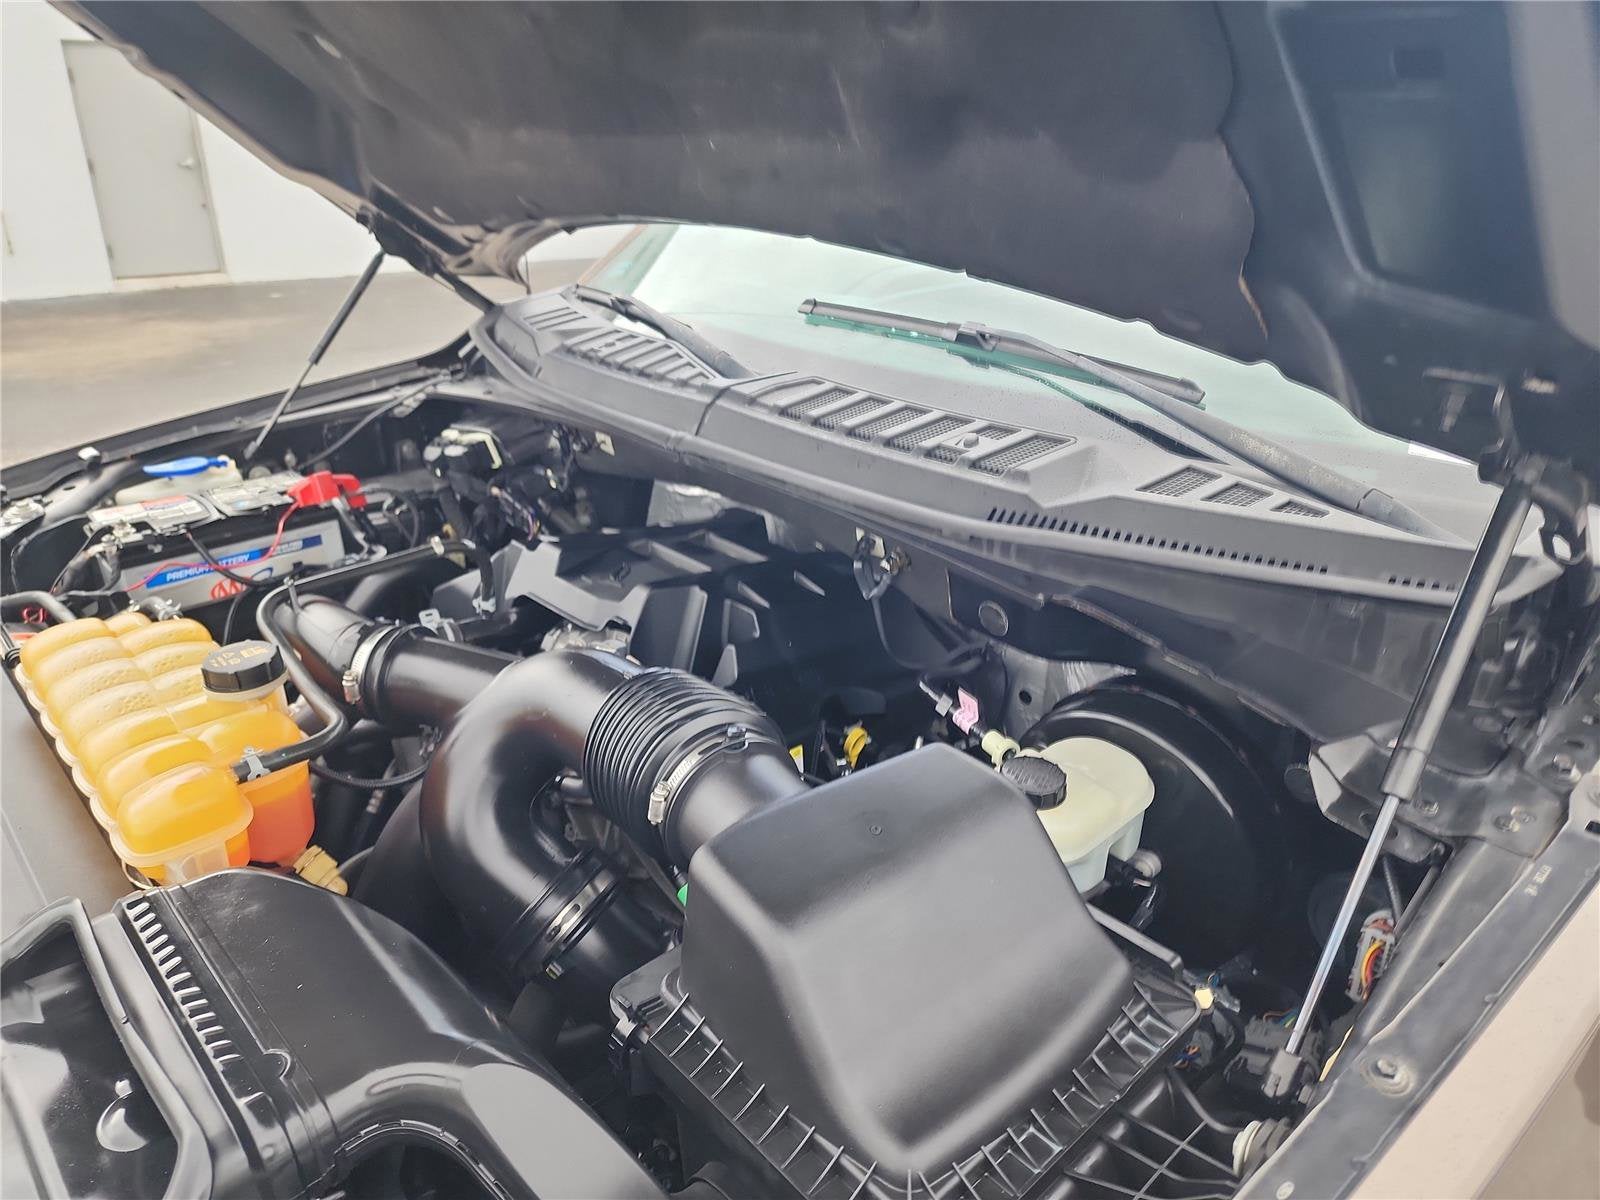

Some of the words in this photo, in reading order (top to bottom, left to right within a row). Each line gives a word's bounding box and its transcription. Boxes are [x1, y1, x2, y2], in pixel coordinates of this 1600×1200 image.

[166, 565, 210, 582] PREMIUM
[209, 553, 250, 573] TTERY
[210, 578, 248, 601] AA
